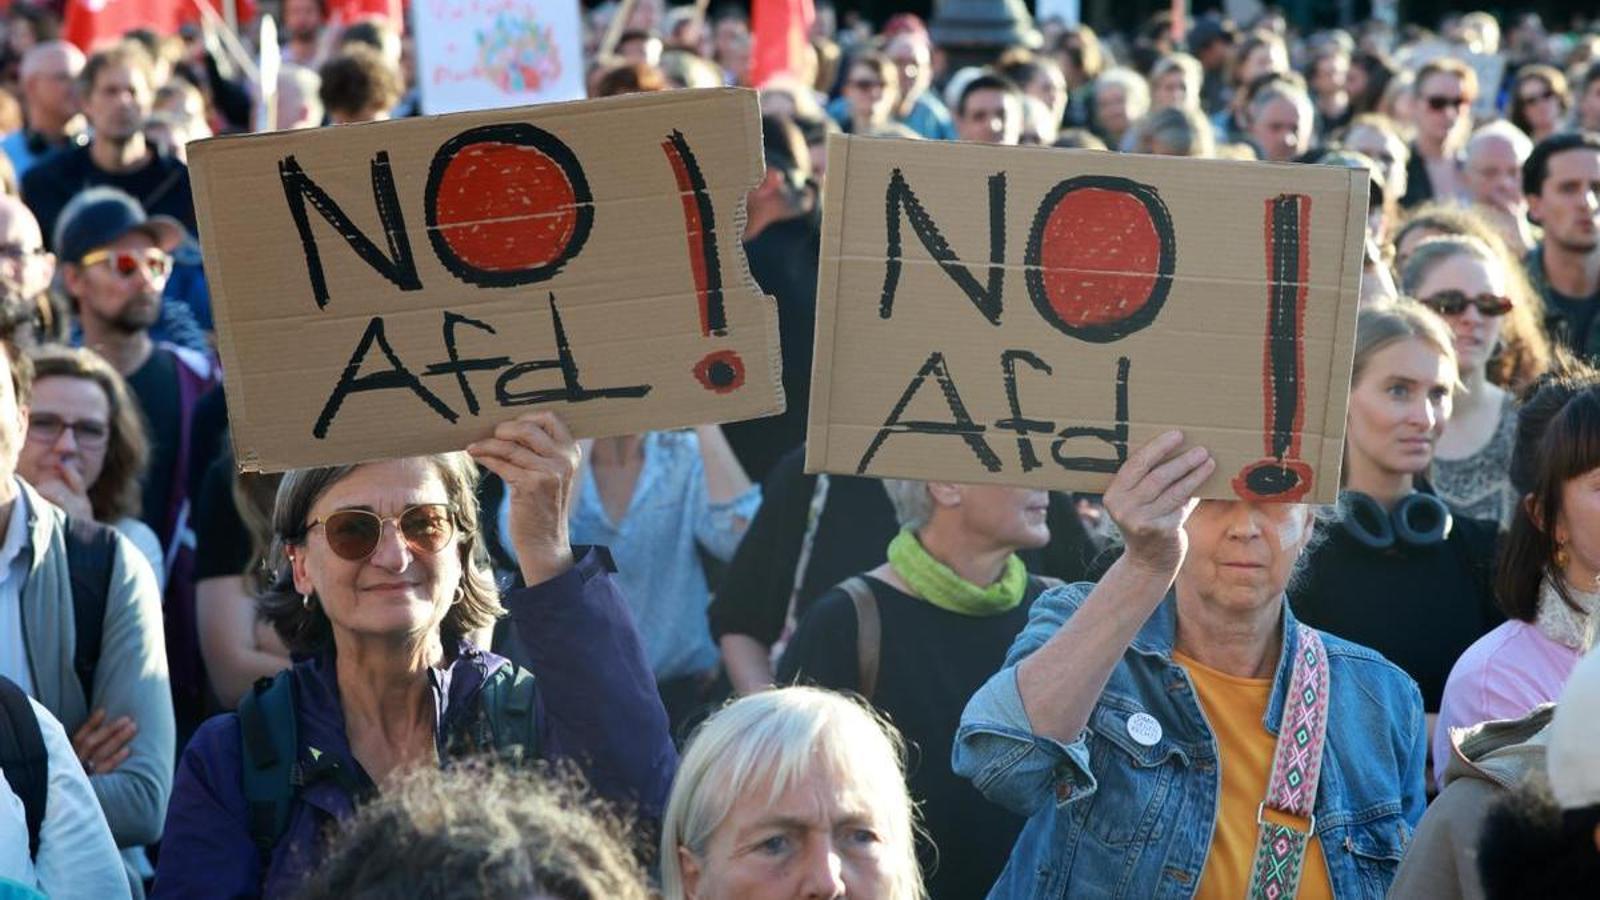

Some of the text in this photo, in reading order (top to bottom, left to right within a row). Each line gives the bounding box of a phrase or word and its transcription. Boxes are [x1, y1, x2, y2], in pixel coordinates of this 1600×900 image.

[277, 122, 595, 310] NO
[879, 168, 1176, 343] NO
[312, 292, 652, 440] Afd
[857, 350, 1131, 474] Afd
